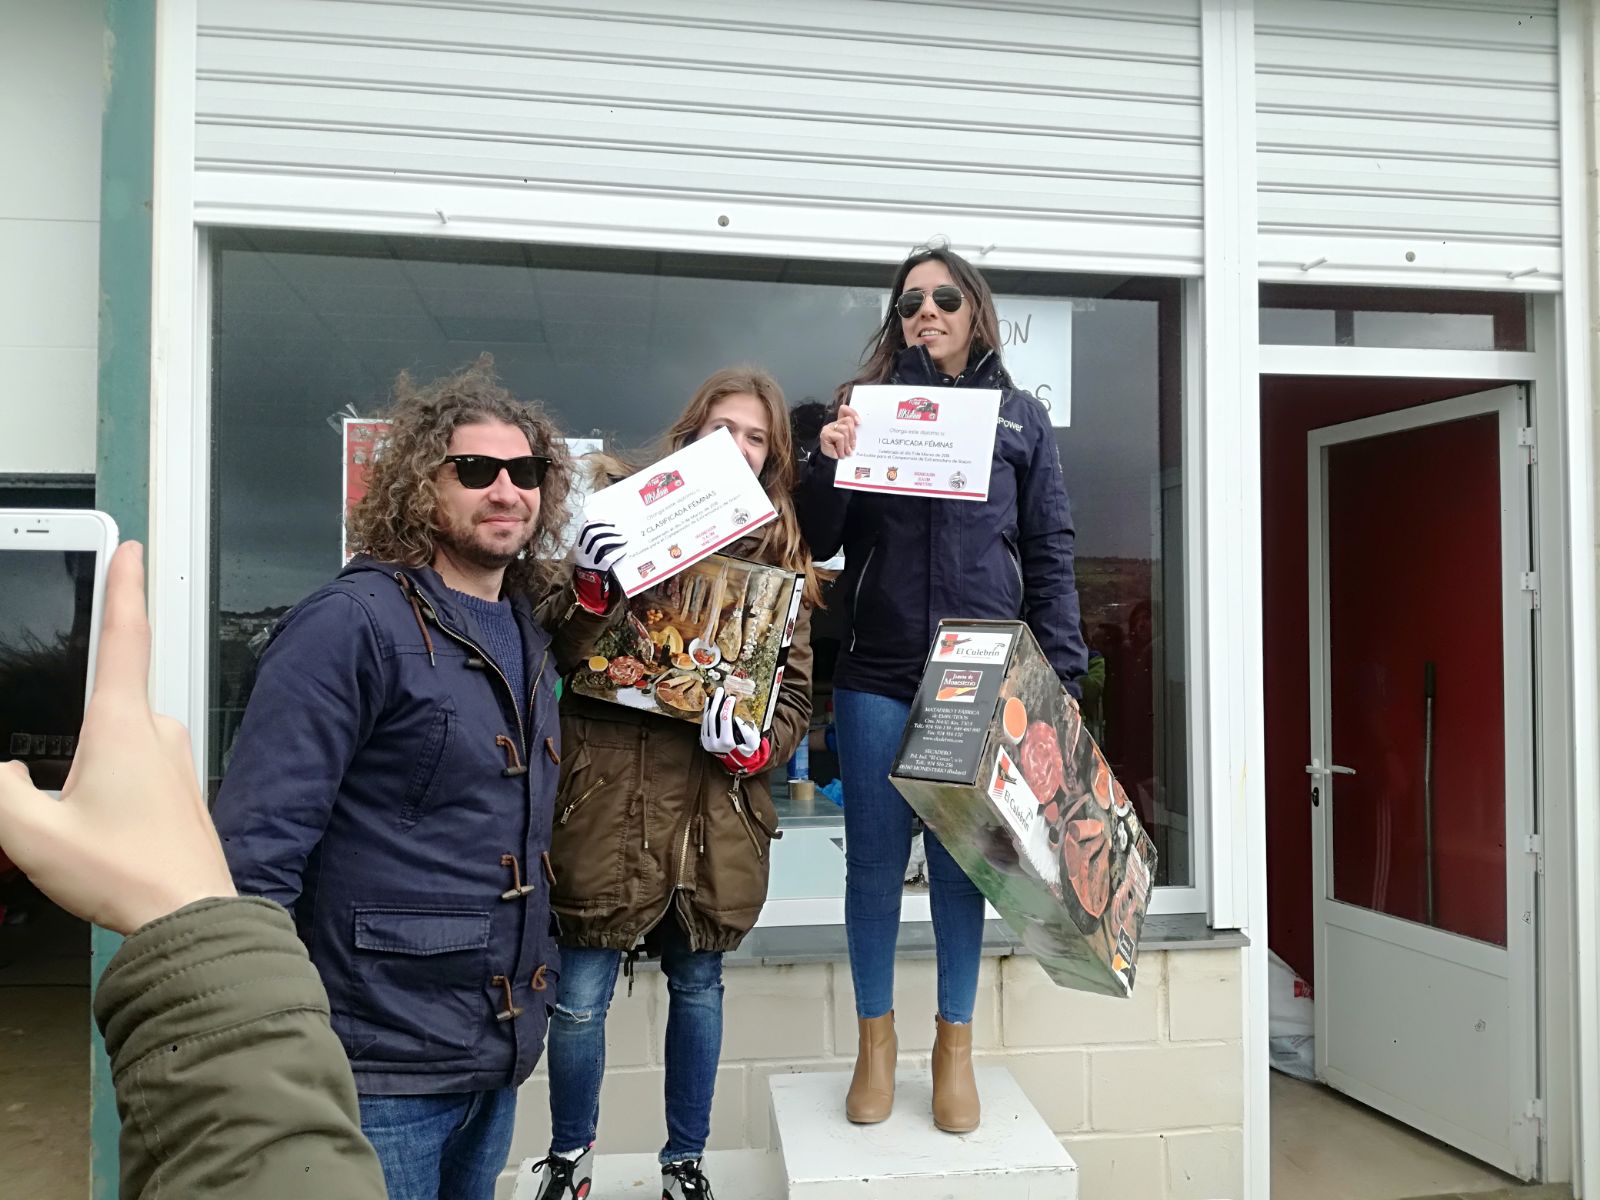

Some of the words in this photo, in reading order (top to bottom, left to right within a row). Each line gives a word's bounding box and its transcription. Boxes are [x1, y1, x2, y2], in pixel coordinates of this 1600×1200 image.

[880, 437, 924, 447] CLASIFICADA
[644, 505, 689, 534] CLASIFICADA
[956, 647, 964, 655] El
